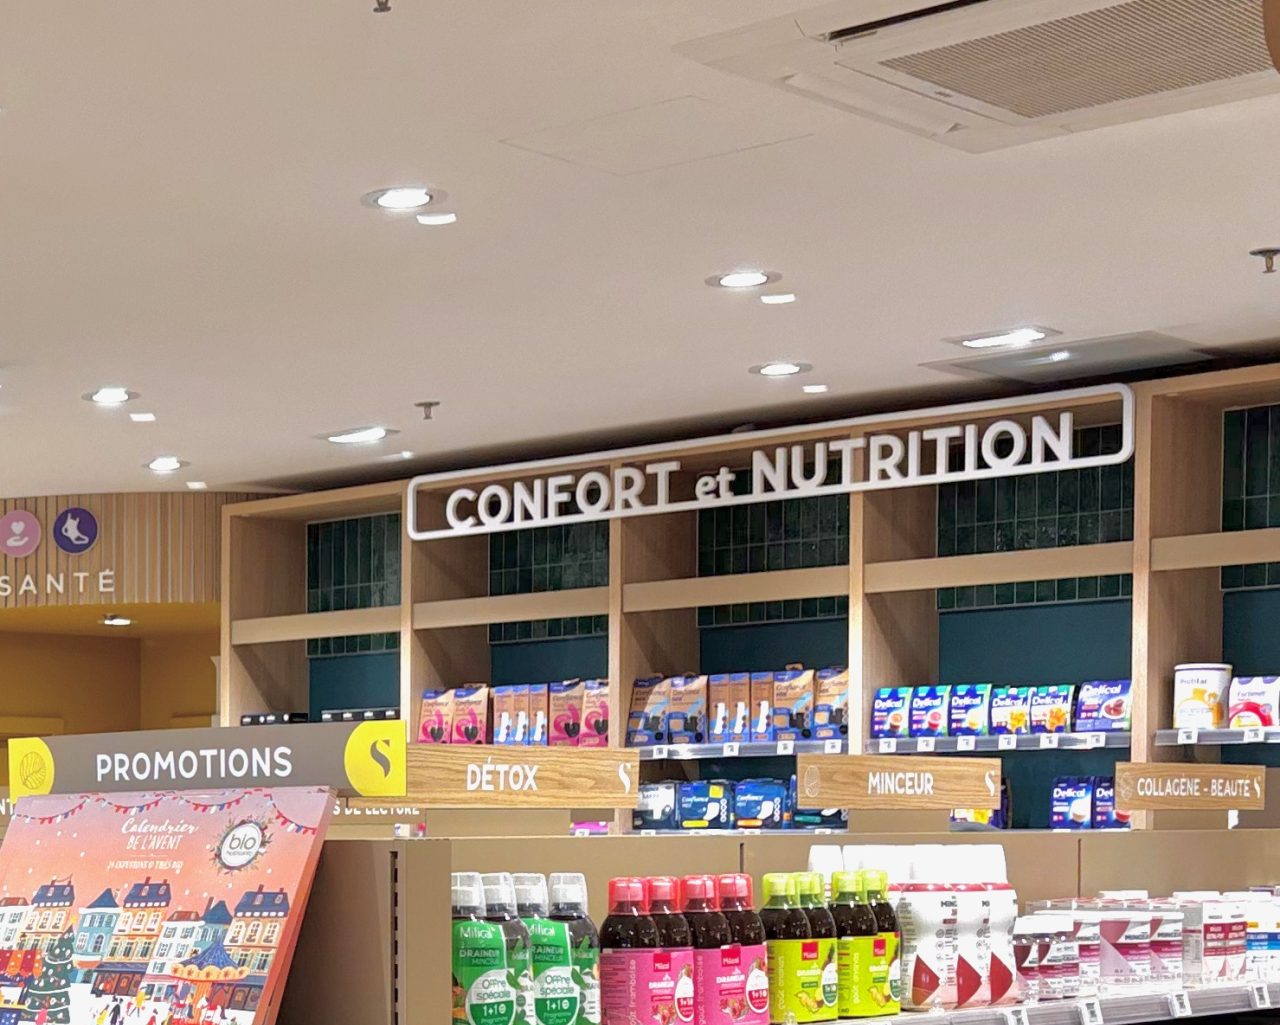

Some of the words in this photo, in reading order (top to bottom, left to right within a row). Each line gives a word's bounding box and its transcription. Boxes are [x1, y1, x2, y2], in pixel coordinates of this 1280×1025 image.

[445, 461, 681, 531] CONFORT
[695, 466, 734, 502] et
[752, 411, 1074, 494] NUTRITION
[96, 745, 293, 783] PROMOTIONS
[466, 756, 539, 791] DÉTOX
[867, 771, 935, 796] MINCEUR
[1136, 773, 1201, 797] COLLAGÈNE
[1210, 774, 1251, 798] BEAUTÉ
[121, 817, 199, 834] Calendrier
[228, 834, 256, 851] bio
